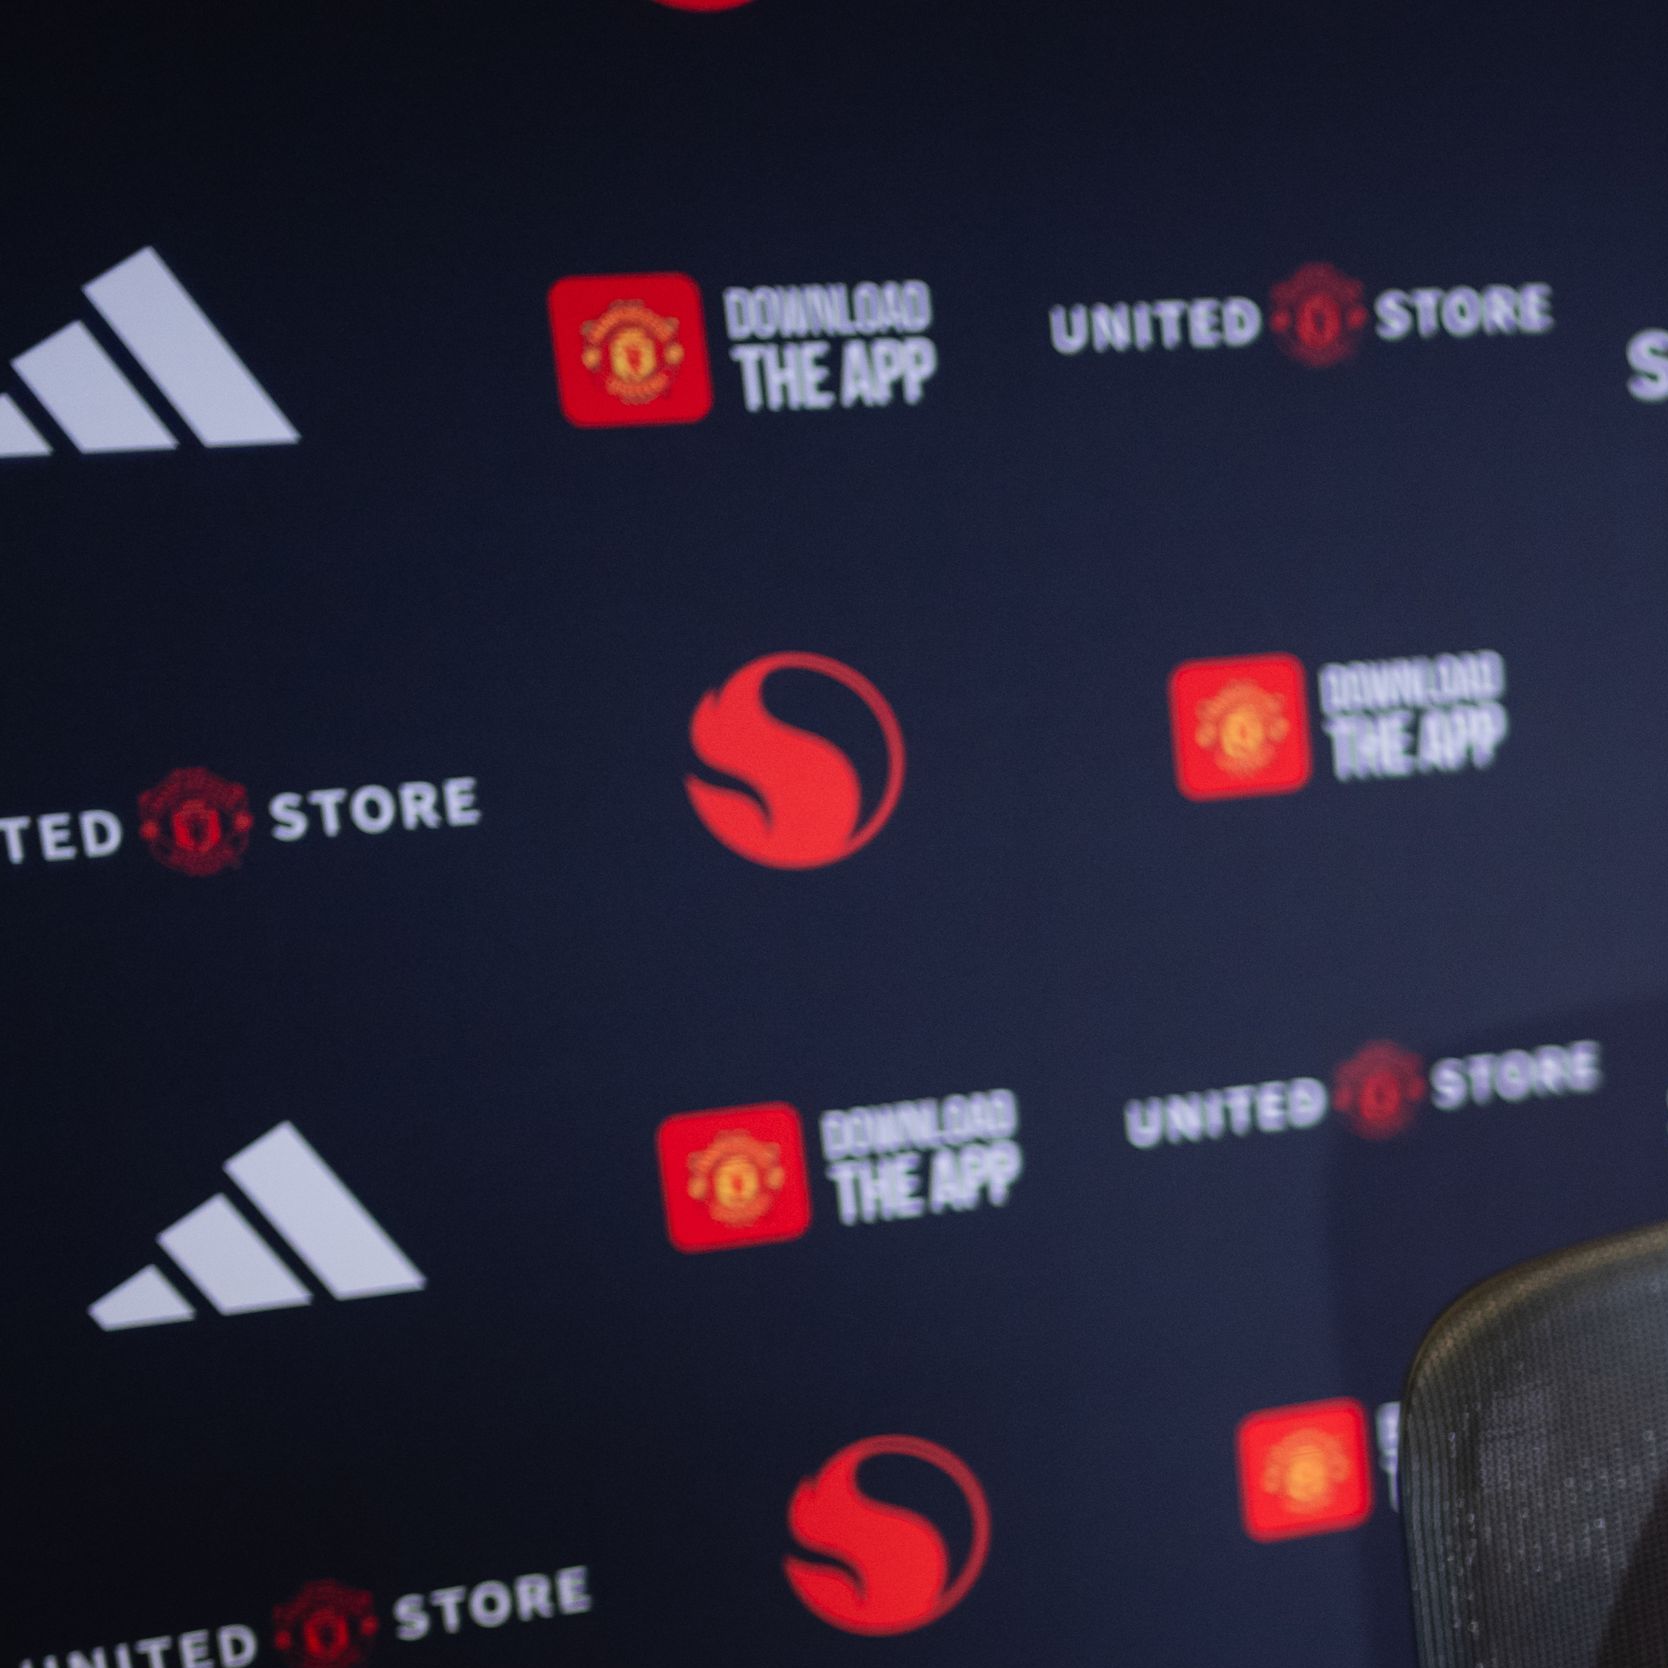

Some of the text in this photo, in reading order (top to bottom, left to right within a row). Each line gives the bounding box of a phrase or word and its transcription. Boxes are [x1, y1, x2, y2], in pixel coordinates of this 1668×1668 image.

[723, 279, 932, 340] DOWNLOAD
[1050, 283, 1553, 354] UNITED STORE
[730, 336, 937, 412] THE APP
[1318, 649, 1506, 716] DOWNLOAD
[1323, 701, 1509, 781] THE APP
[269, 777, 481, 841] STORE
[820, 1088, 1018, 1160] DOWNLOAD
[1125, 1041, 1600, 1148] UNITED STORE
[826, 1137, 1022, 1226] THE APP
[394, 1566, 590, 1640] STORE
